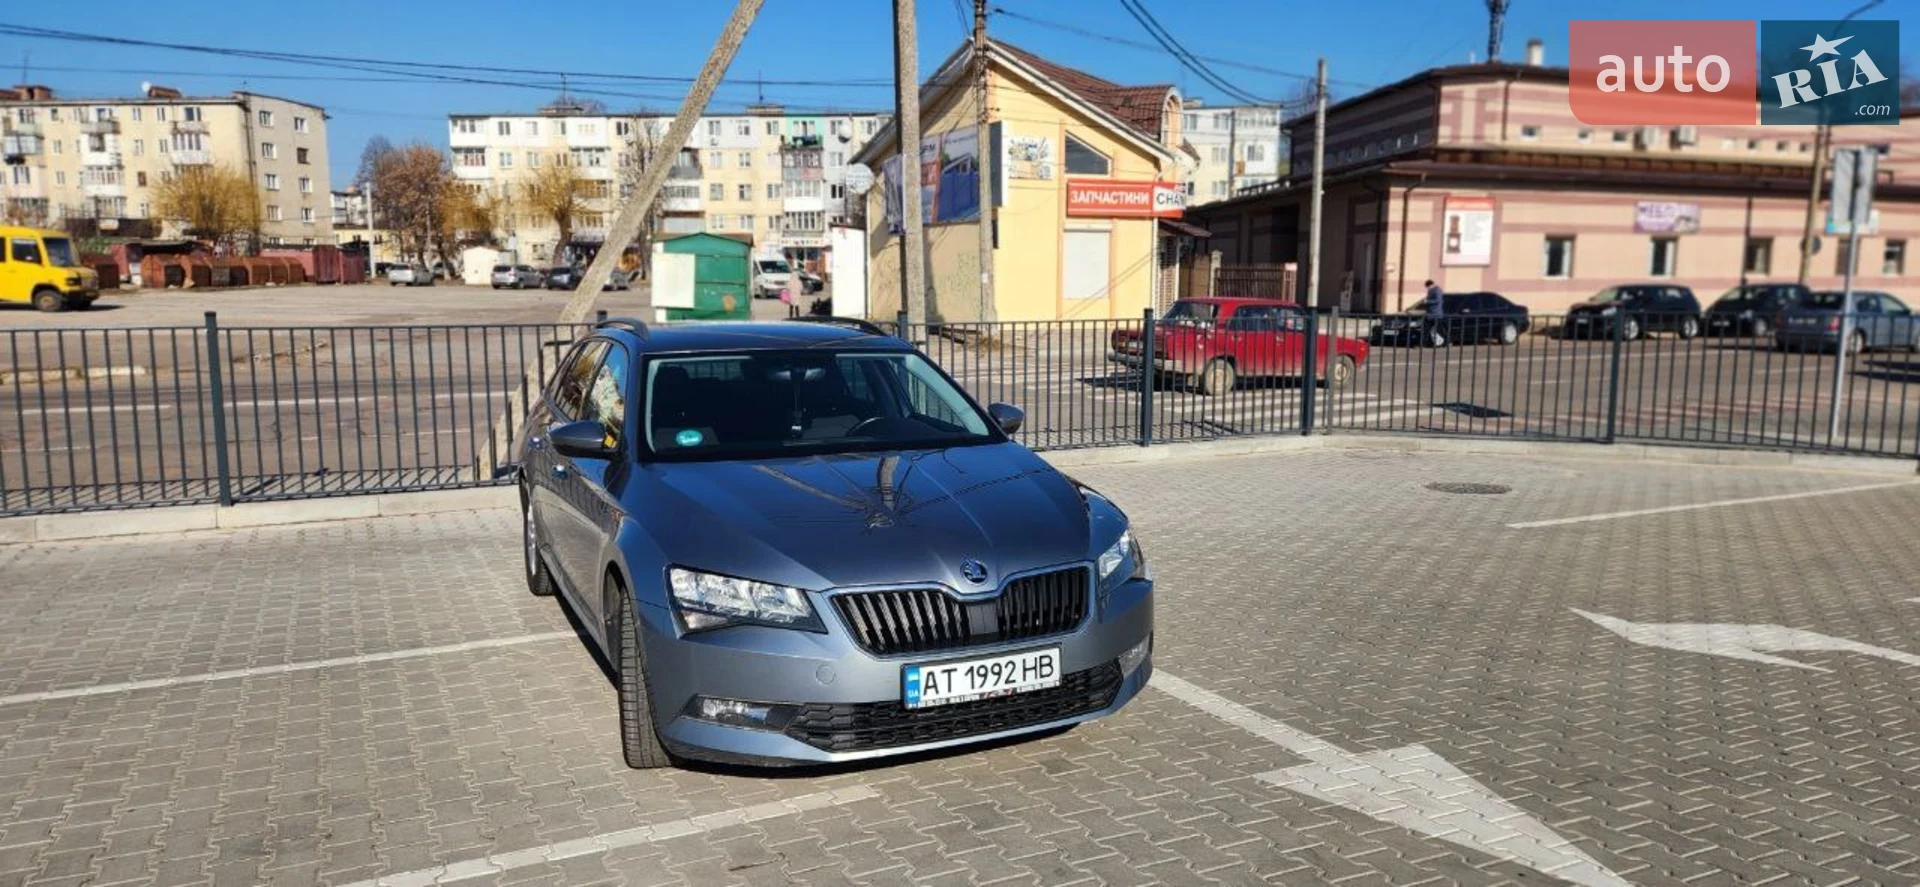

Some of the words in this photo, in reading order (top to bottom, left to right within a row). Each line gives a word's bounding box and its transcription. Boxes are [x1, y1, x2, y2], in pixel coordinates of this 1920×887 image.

[1070, 190, 1149, 205] ЗАПЧАСТИНИ
[923, 668, 958, 696] AT
[964, 660, 1016, 690] 1992
[1022, 654, 1054, 682] HB
